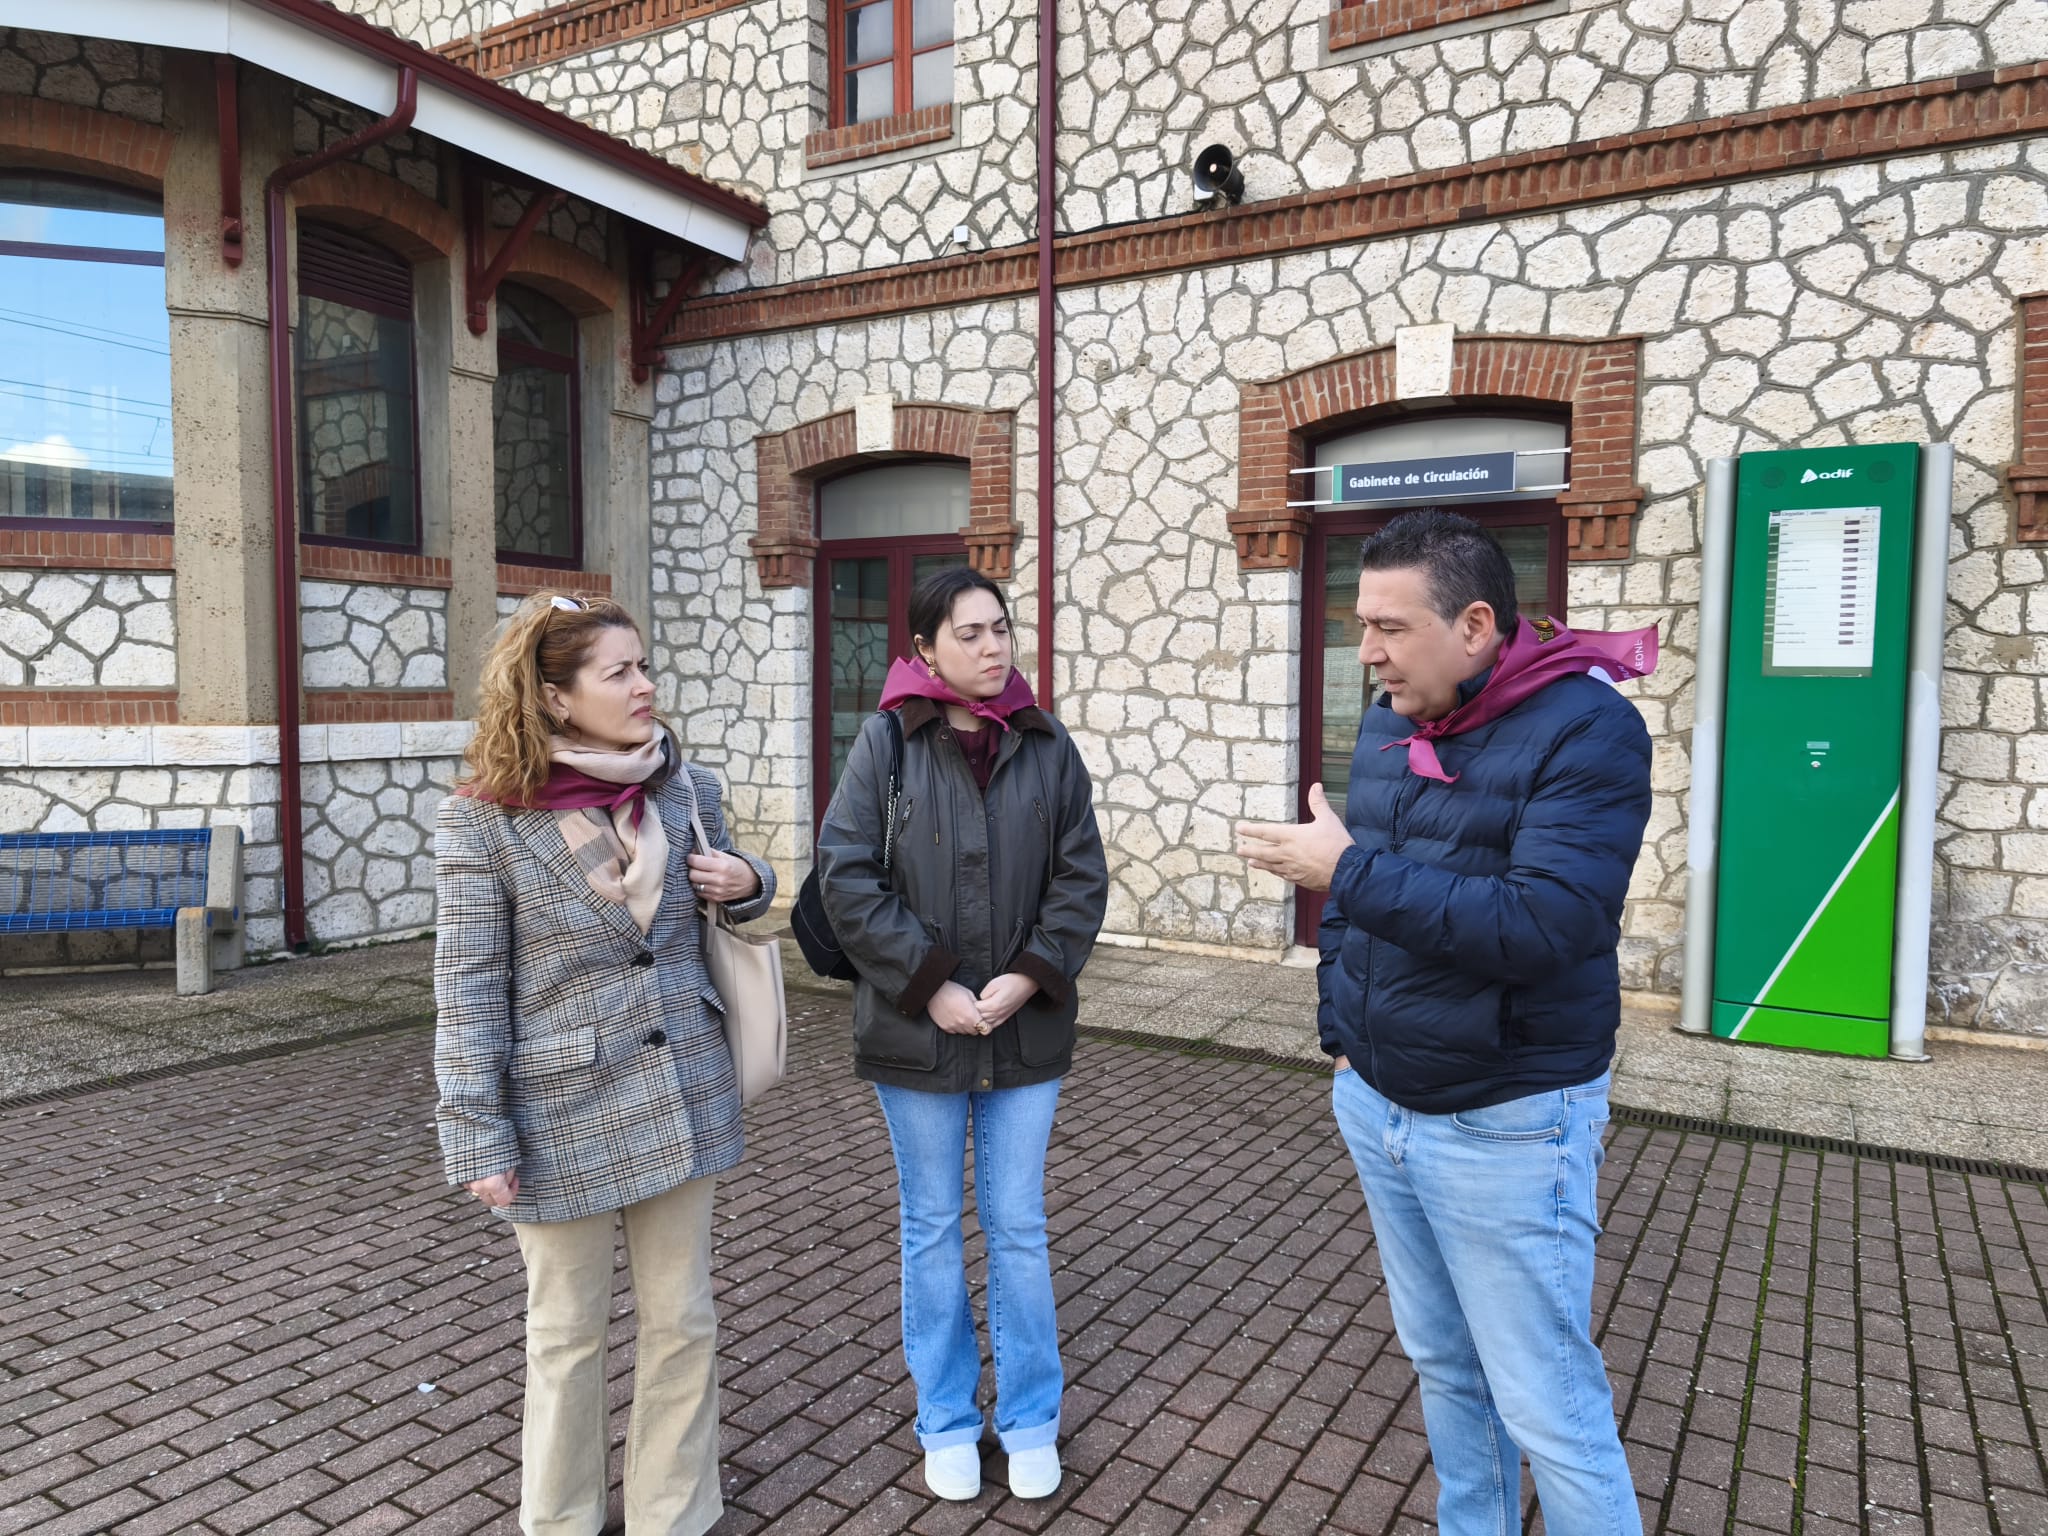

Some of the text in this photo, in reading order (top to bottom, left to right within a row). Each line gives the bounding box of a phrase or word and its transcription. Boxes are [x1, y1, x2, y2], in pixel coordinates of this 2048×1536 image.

[1349, 467, 1489, 488] Gabinete de Circulación
[1818, 468, 1855, 479] adif
